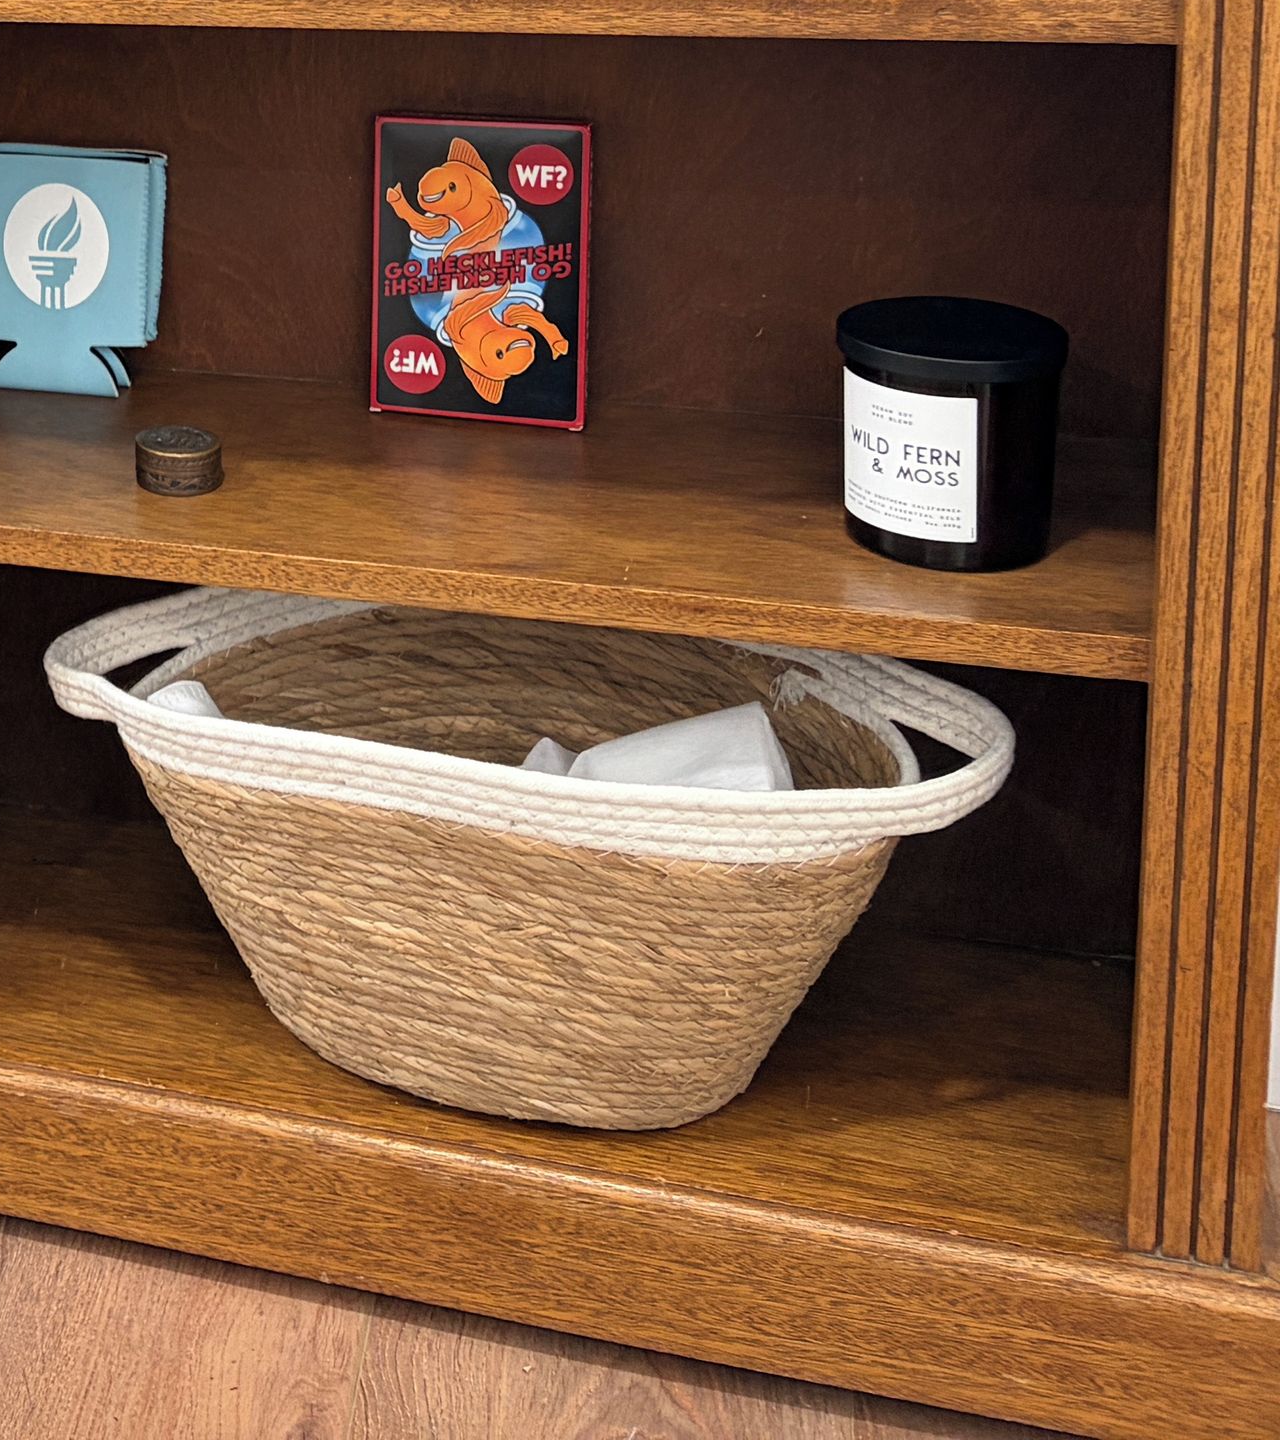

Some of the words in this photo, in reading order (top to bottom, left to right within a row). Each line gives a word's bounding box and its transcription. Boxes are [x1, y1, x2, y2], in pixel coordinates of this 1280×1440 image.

[515, 164, 568, 190] WF?
[384, 260, 422, 280] GO
[427, 242, 573, 276] HECKLEFISH!
[532, 261, 572, 281] GO
[384, 266, 526, 297] HECKLEFISH!
[390, 348, 439, 376] WF?
[851, 424, 889, 455] WILD
[904, 444, 960, 467] FERN
[872, 458, 884, 474] &
[896, 466, 959, 487] MOSS
